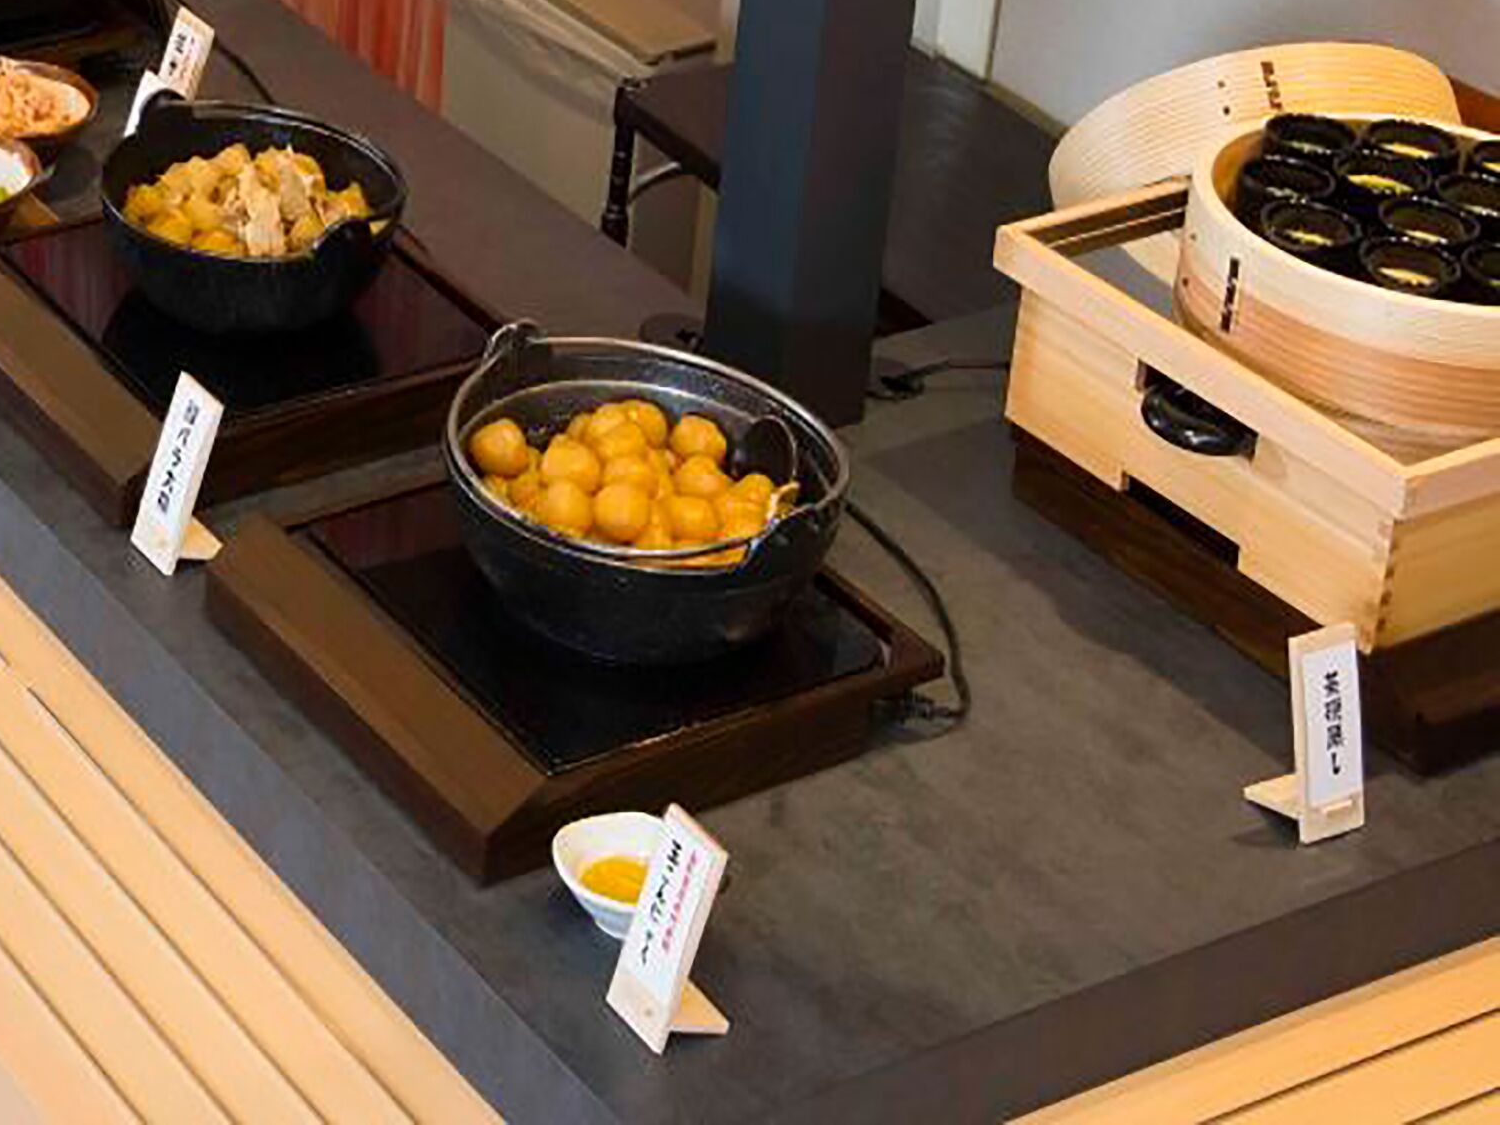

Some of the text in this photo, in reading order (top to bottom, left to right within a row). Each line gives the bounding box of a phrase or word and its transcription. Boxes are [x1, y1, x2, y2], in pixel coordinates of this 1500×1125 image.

[1323, 671, 1346, 776] 茶碗蒸し
[639, 838, 683, 966] 玉こんにゃく
